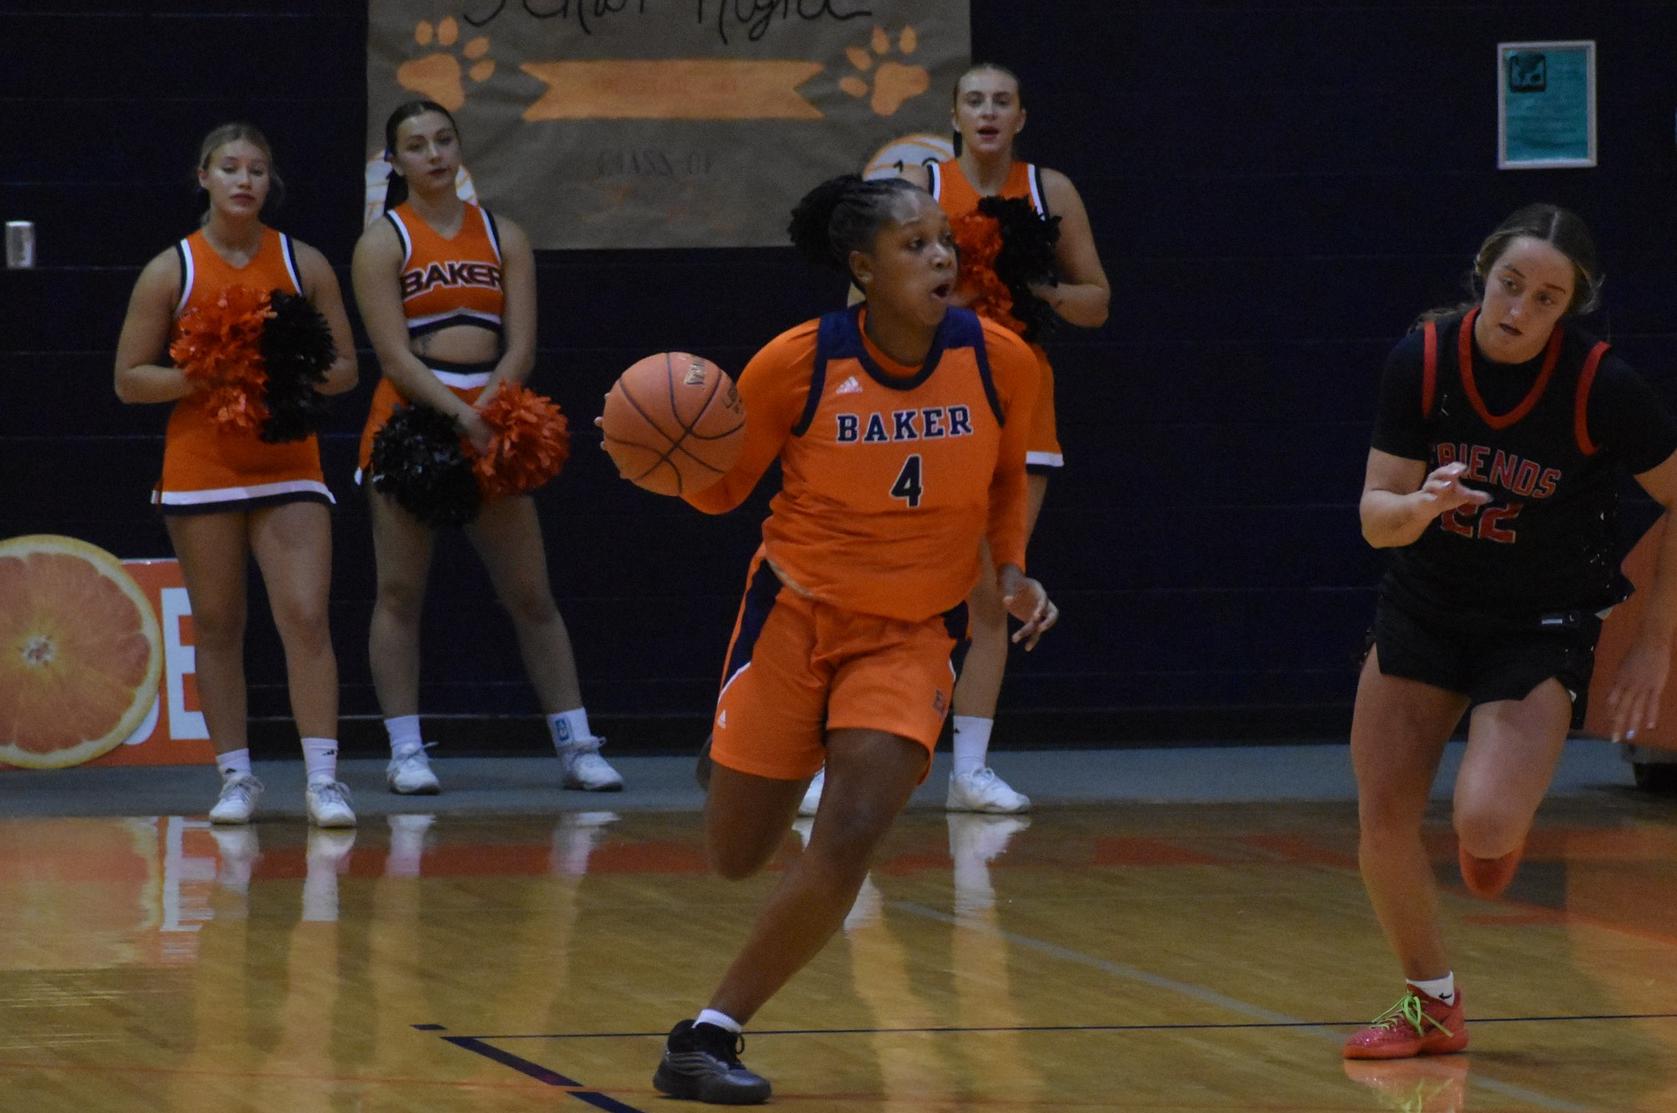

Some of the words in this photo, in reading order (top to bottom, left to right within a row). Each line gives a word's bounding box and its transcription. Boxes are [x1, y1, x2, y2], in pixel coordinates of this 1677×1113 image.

[836, 405, 974, 443] BAKER
[889, 453, 923, 508] 4
[1432, 441, 1563, 500] RIENDS
